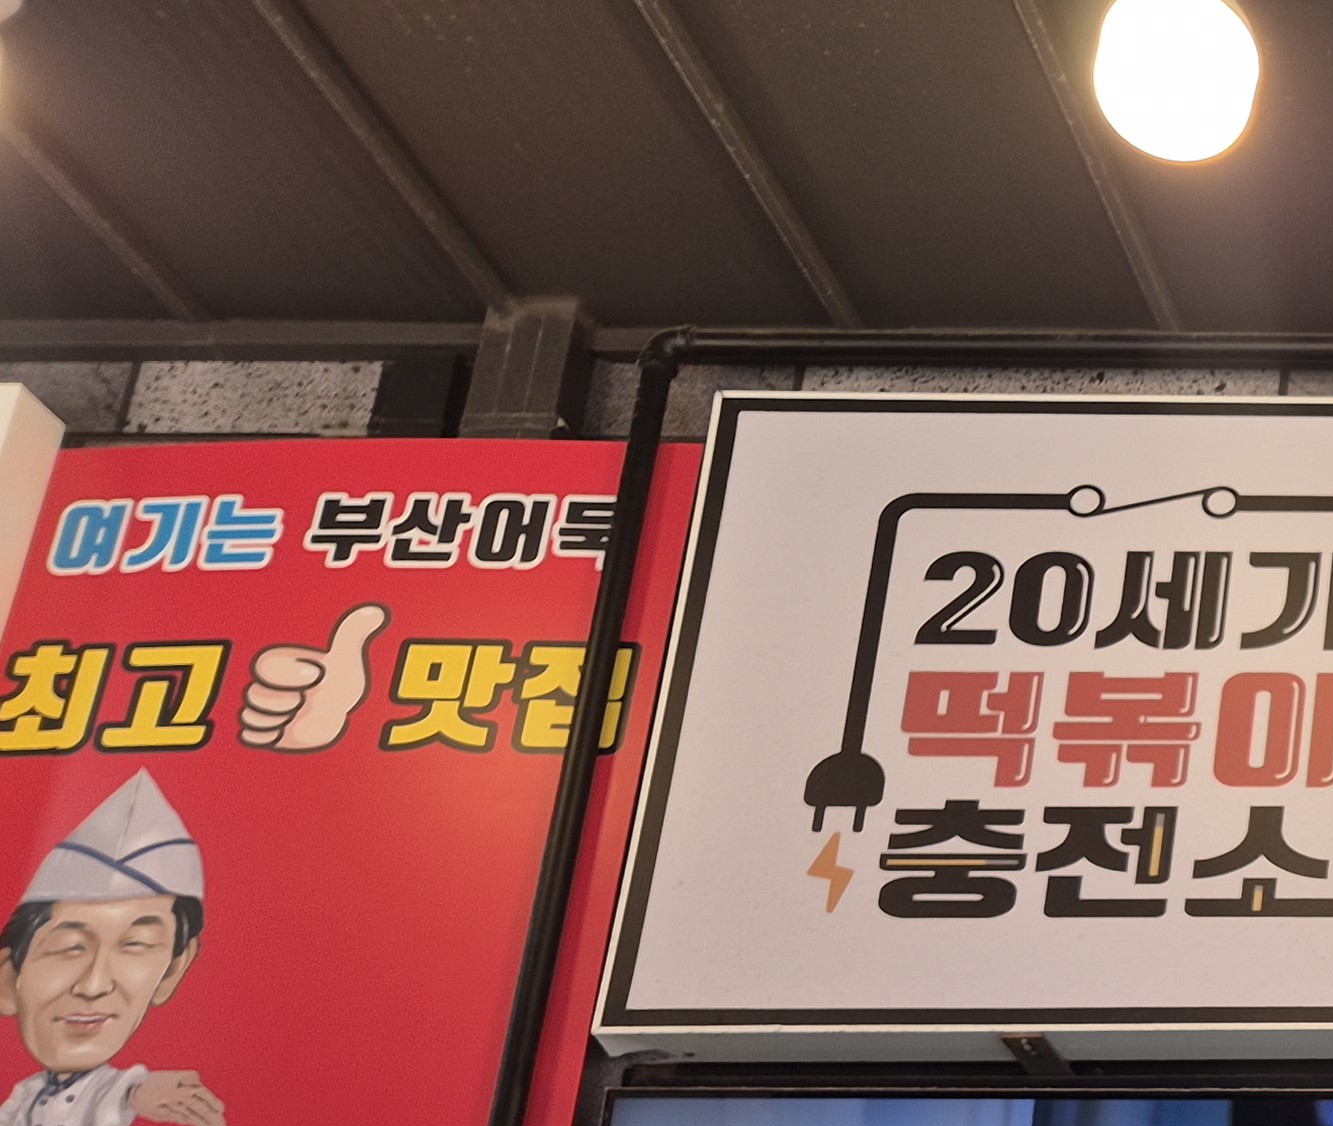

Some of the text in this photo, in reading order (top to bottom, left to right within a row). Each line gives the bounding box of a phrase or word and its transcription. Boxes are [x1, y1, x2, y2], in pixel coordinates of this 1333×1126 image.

[50, 493, 281, 574] 여기는
[0, 637, 638, 752] 최고 맛집
[878, 800, 1330, 918] 충전소
